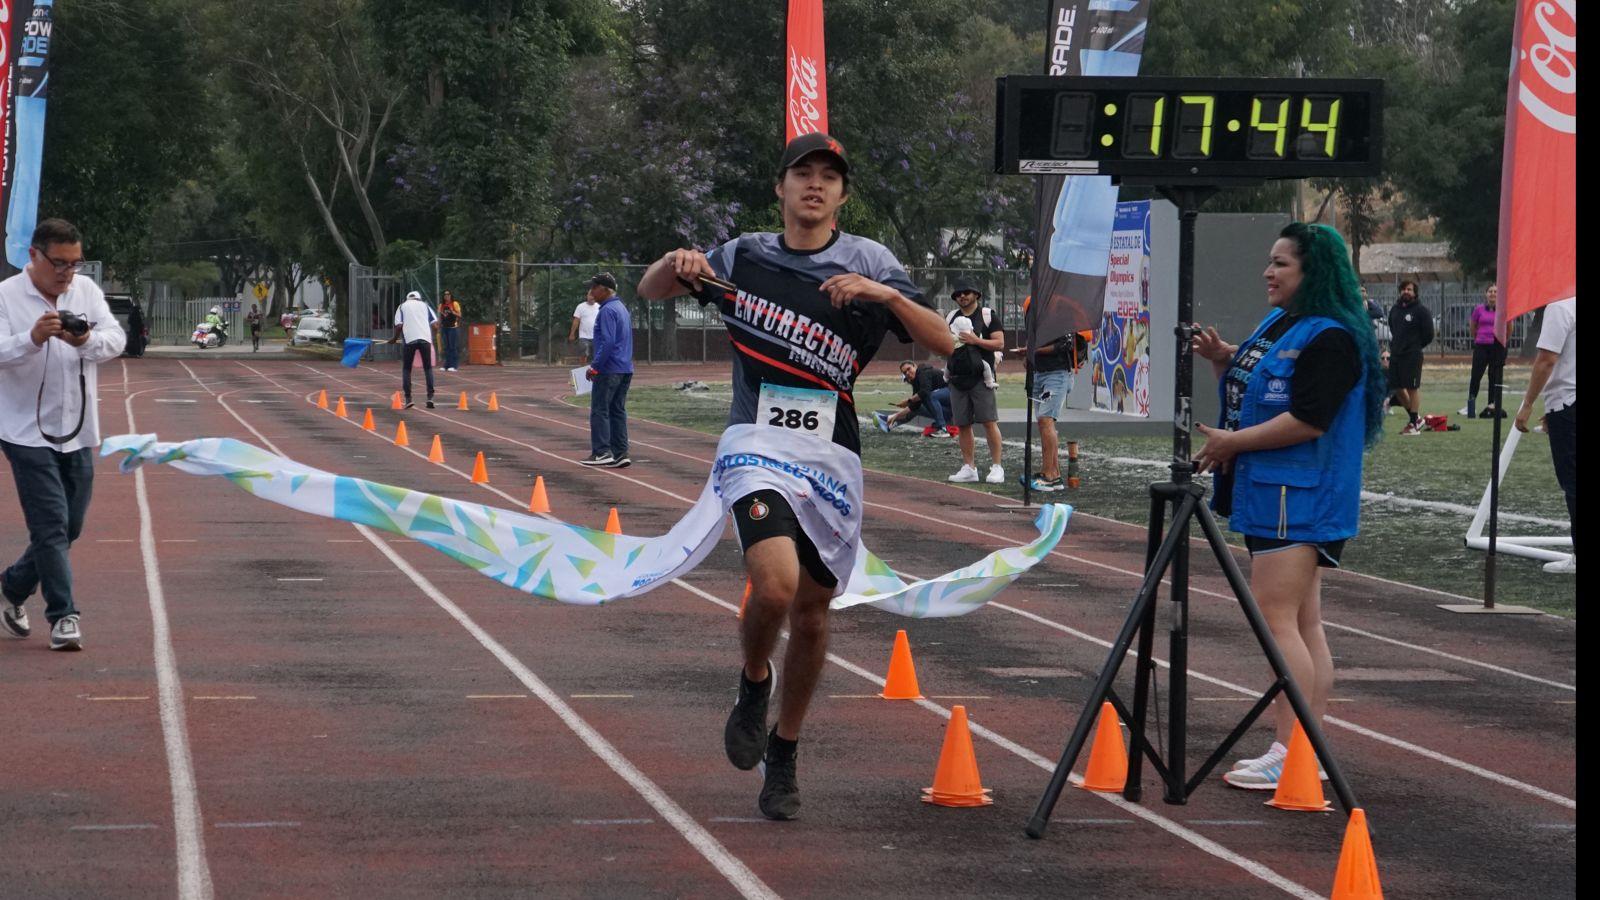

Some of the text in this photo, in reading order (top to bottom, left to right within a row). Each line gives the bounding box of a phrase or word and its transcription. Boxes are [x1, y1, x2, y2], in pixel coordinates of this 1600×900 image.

[1110, 253, 1130, 268] Special
[1109, 270, 1134, 286] Olympics
[1117, 300, 1139, 317] 2024
[768, 406, 819, 431] 286
